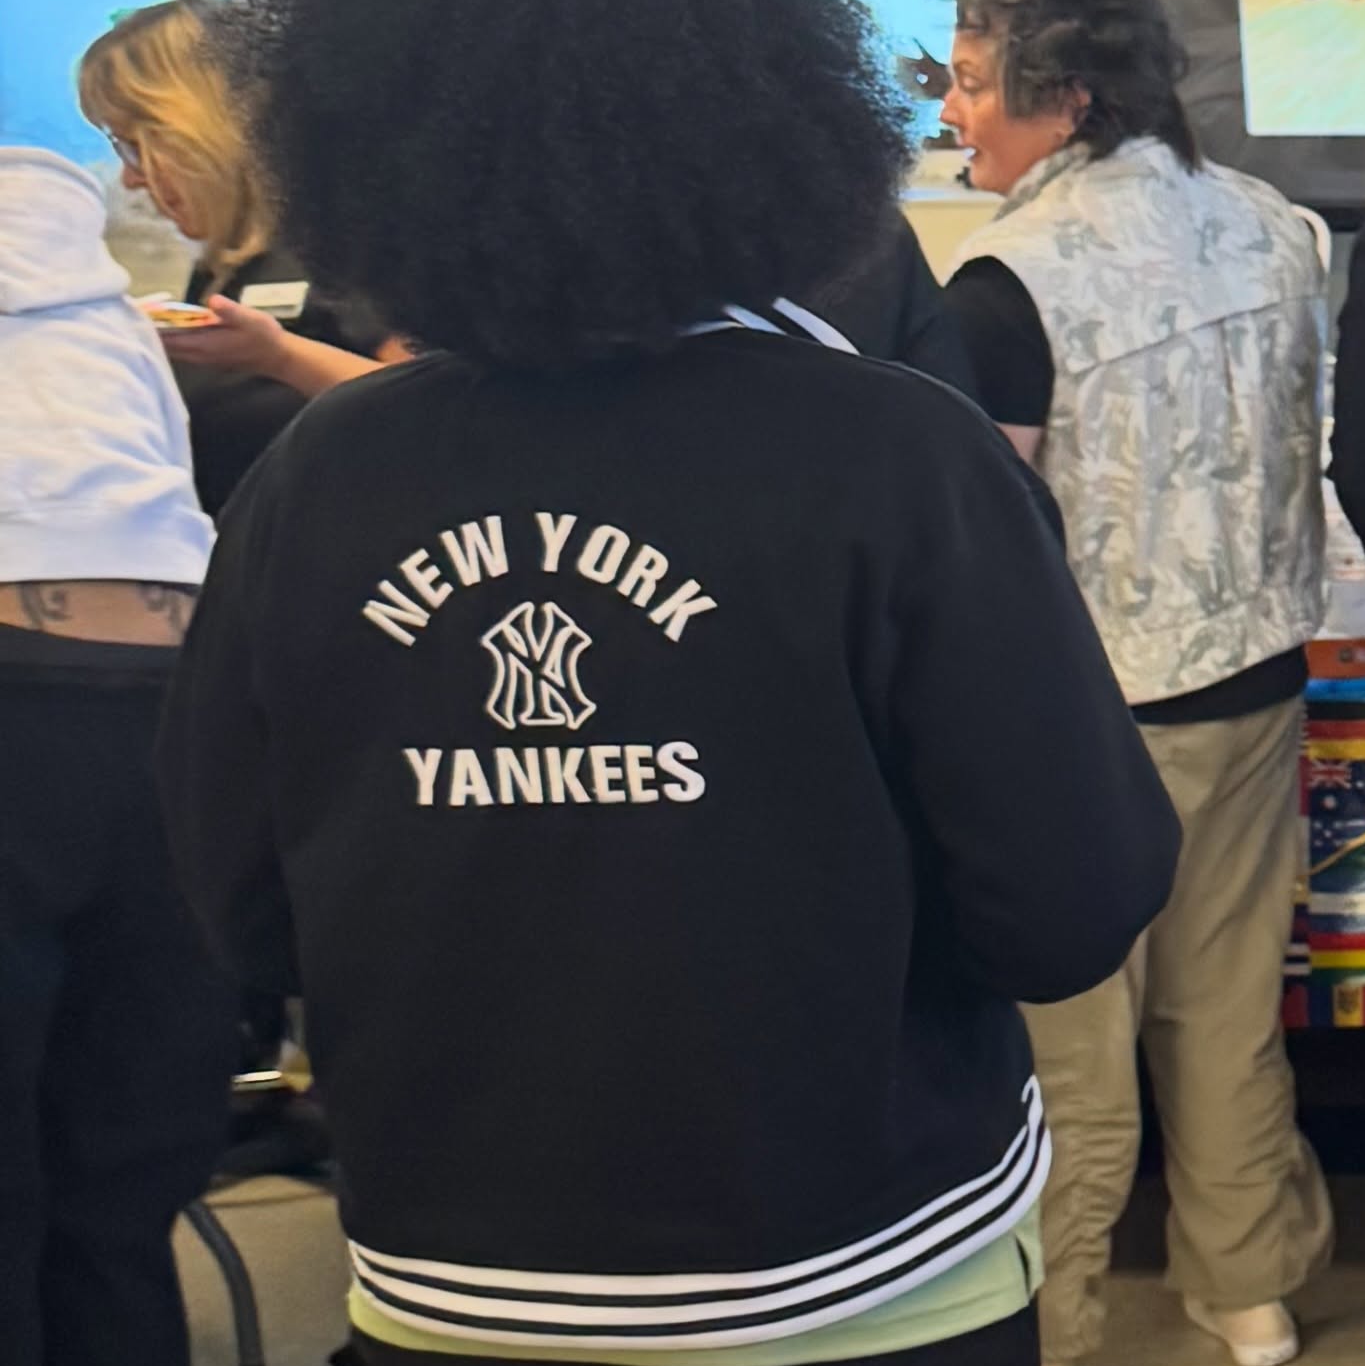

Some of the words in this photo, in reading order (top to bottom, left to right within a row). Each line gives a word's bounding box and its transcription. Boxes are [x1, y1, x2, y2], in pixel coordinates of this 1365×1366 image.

[362, 514, 510, 647] NEW
[534, 511, 718, 643] YORK
[402, 740, 706, 807] YANKEES
